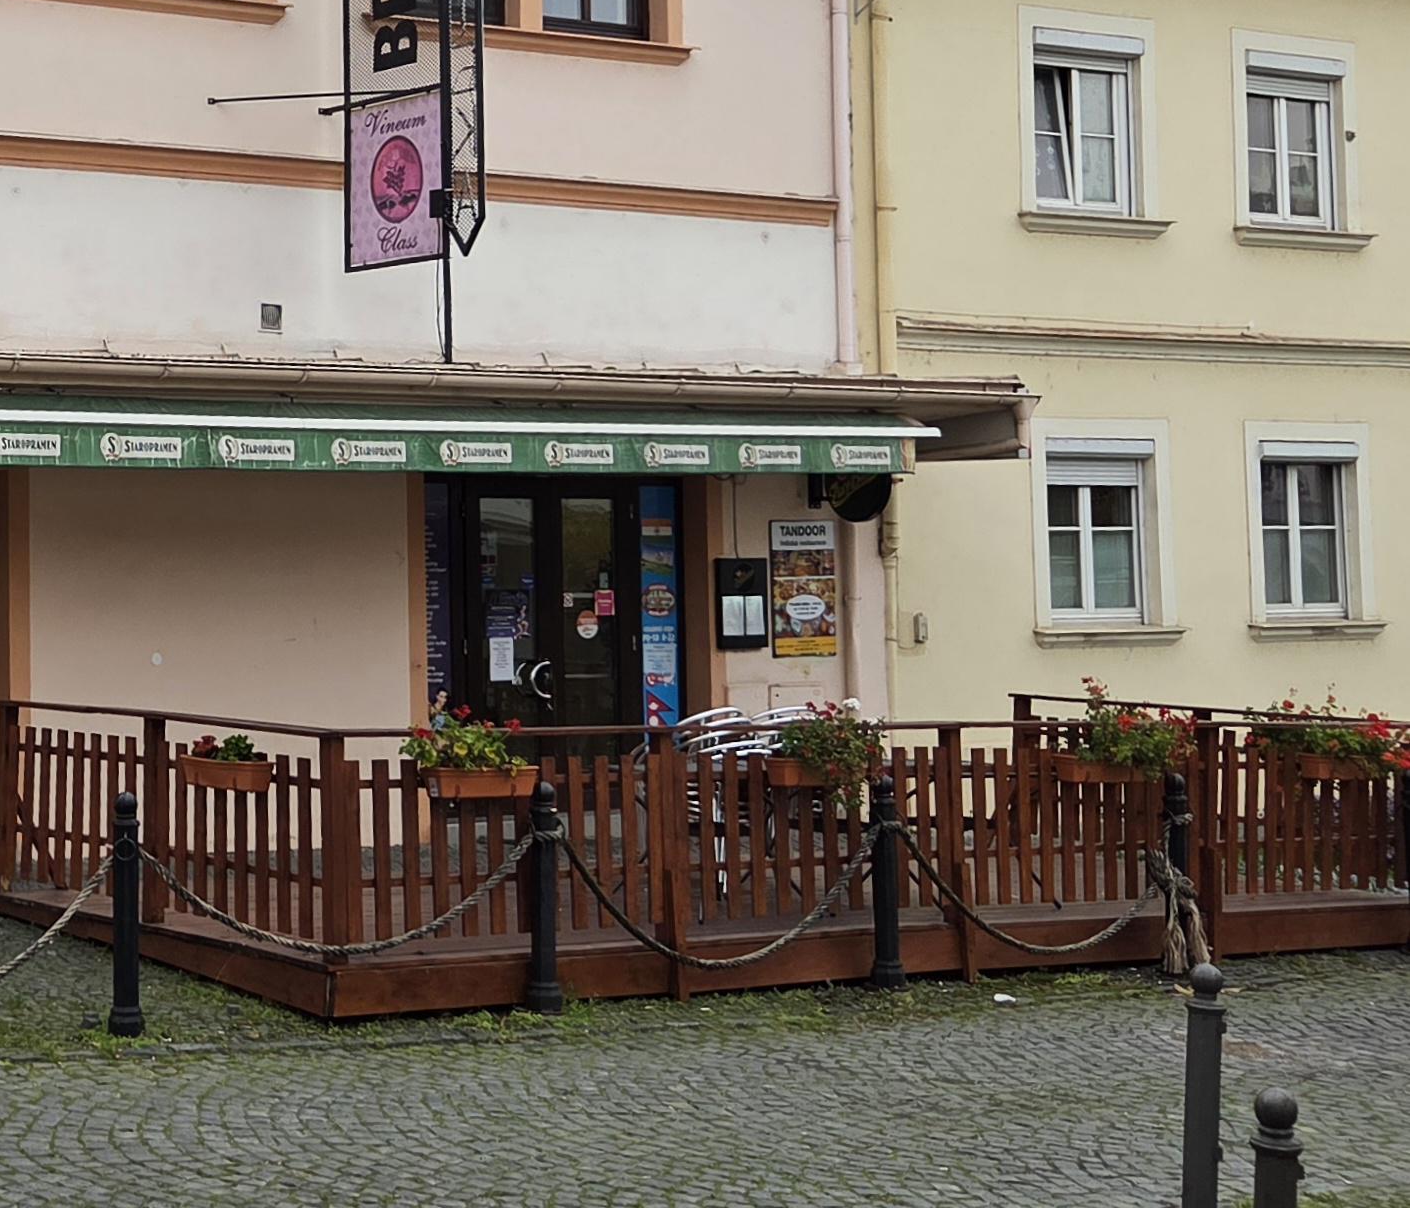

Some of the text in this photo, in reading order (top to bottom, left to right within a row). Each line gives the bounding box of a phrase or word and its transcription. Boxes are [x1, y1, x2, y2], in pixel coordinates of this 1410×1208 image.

[365, 110, 427, 137] Vineum
[377, 226, 418, 253] Class
[1, 437, 57, 450] STAROPRAMEN
[107, 436, 116, 453] S
[124, 440, 178, 452] STAROPRAMEN
[225, 438, 232, 456] S
[338, 441, 345, 458] S
[446, 442, 453, 459] S
[551, 443, 557, 459] S
[779, 525, 827, 537] TANDOOR
